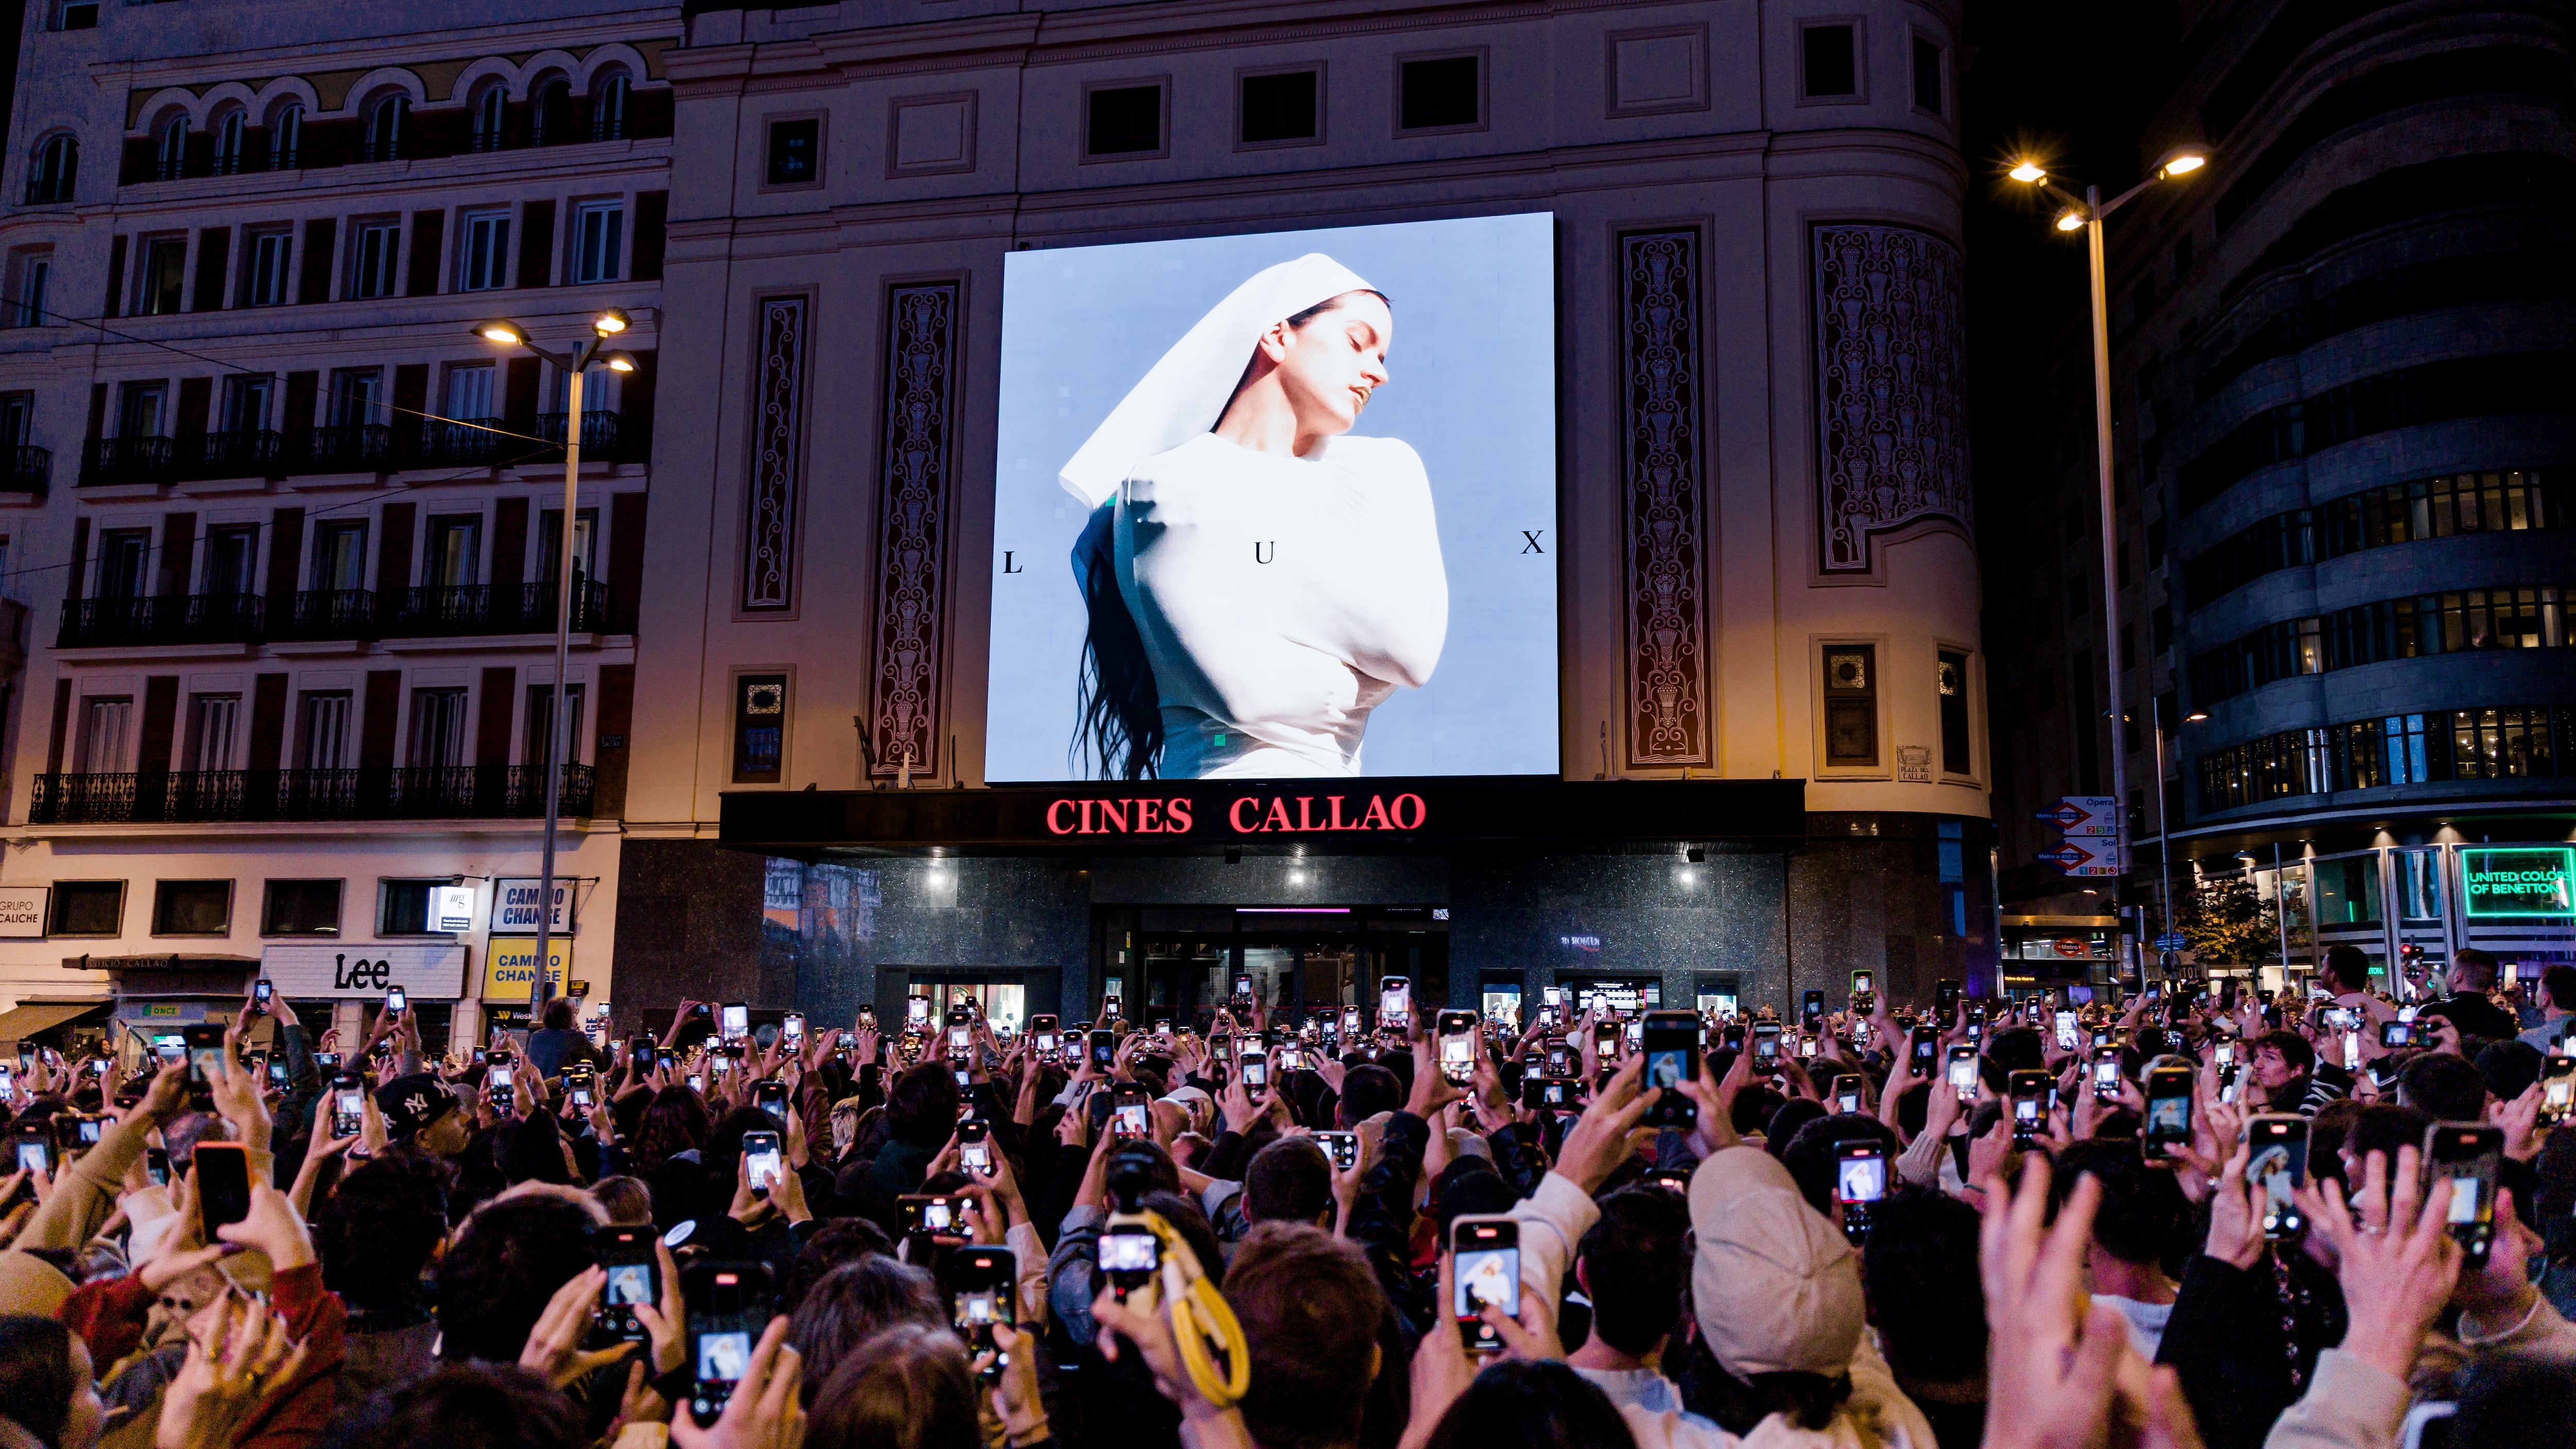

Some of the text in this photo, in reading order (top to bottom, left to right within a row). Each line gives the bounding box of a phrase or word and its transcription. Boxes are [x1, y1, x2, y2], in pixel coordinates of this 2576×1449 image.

[1003, 531, 1545, 573] L U X
[1047, 793, 1426, 834] CINES CALLAO
[2469, 871, 2572, 882] UNITED COLORS
[2470, 884, 2489, 894] OF
[506, 888, 565, 905] CAMO
[0, 901, 33, 911] GRUPO
[0, 914, 38, 923] CALICHE
[127, 959, 168, 968] CALLAO
[499, 955, 561, 966] CAMO
[334, 953, 389, 990] Lee
[404, 1093, 428, 1114] NY
